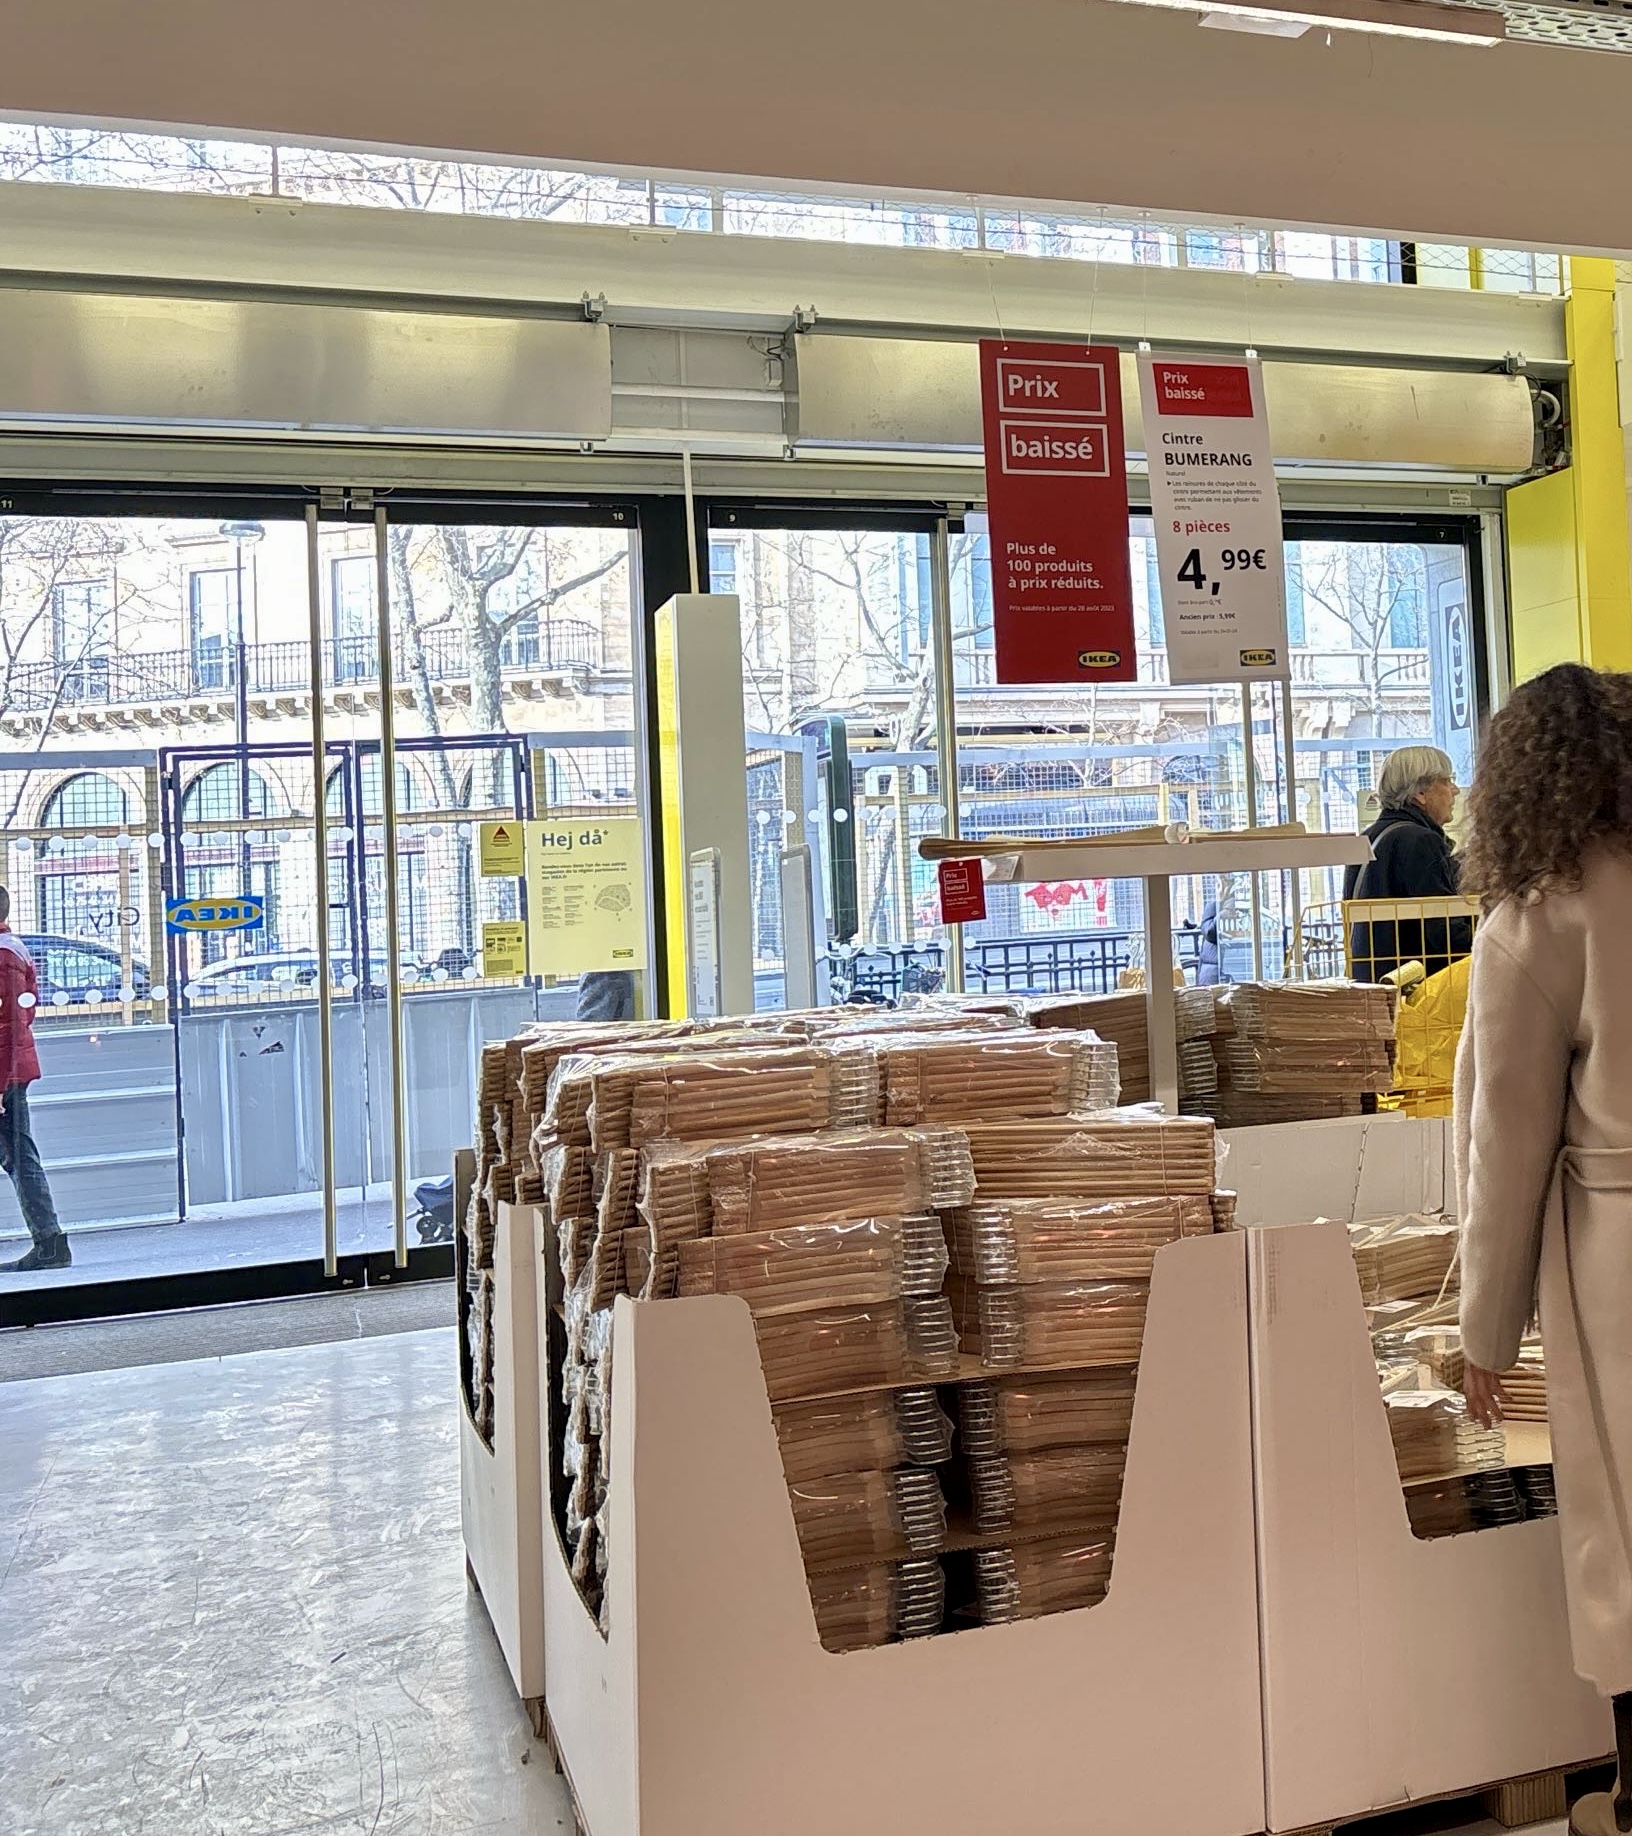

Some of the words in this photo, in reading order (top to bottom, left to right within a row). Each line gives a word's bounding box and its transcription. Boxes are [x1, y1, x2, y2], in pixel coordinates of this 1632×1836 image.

[1163, 372, 1189, 384] Prix
[1008, 374, 1059, 398] Prix
[1165, 387, 1205, 399] baissé
[1162, 433, 1204, 445] Cintre
[1011, 434, 1093, 460] baissé
[1165, 453, 1253, 467] BUMERANG
[1, 500, 13, 509] 11
[613, 513, 624, 521] 10
[729, 514, 736, 522] 9
[1172, 520, 1181, 533] 8
[1185, 519, 1231, 536] pièces
[1006, 542, 1036, 555] Plus
[1039, 543, 1057, 555] de
[1006, 560, 1032, 572] 100
[1035, 560, 1093, 575] produits
[1008, 576, 1017, 589] à
[1020, 576, 1048, 592] prix
[1051, 576, 1104, 589] réduits.
[1009, 604, 1020, 612] Prix
[1081, 655, 1118, 663] IKEA
[1243, 653, 1273, 661] IKEA
[1452, 614, 1465, 716] IKEA
[541, 832, 573, 850] Hej
